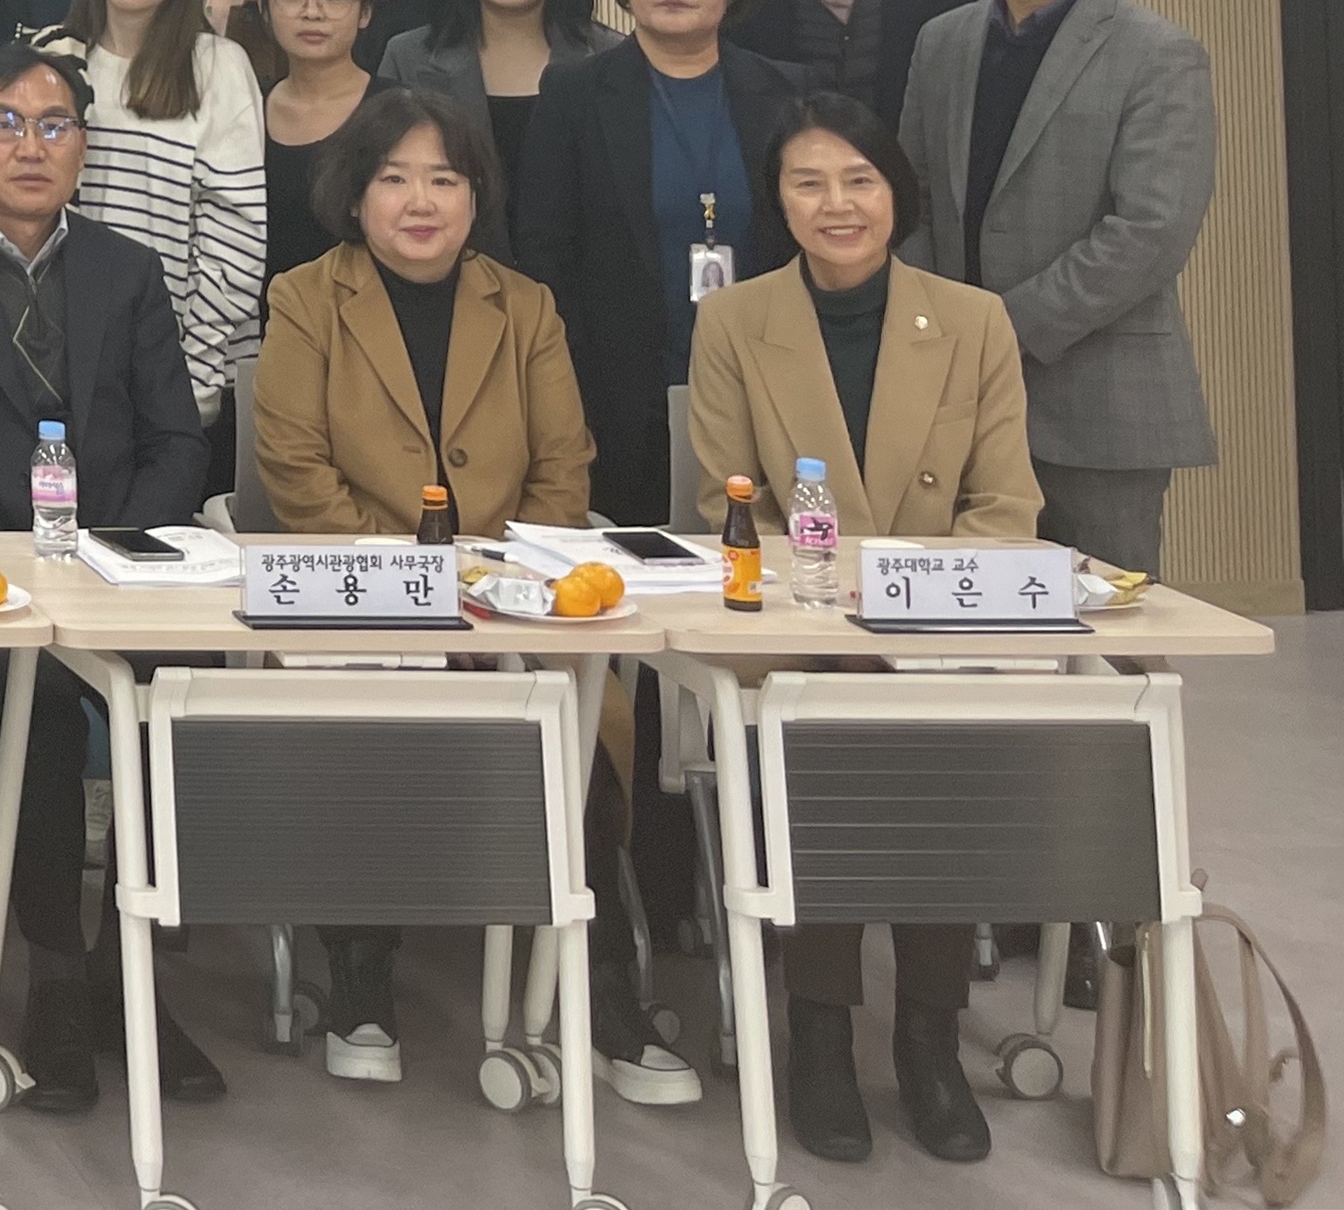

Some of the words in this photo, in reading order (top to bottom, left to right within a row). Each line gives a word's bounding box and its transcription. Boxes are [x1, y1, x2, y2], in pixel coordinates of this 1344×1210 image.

[261, 554, 383, 573] 광주광역시관광협회
[390, 554, 445, 574] 사무국장
[876, 558, 945, 575] 광주대학교
[951, 558, 980, 574] 교수
